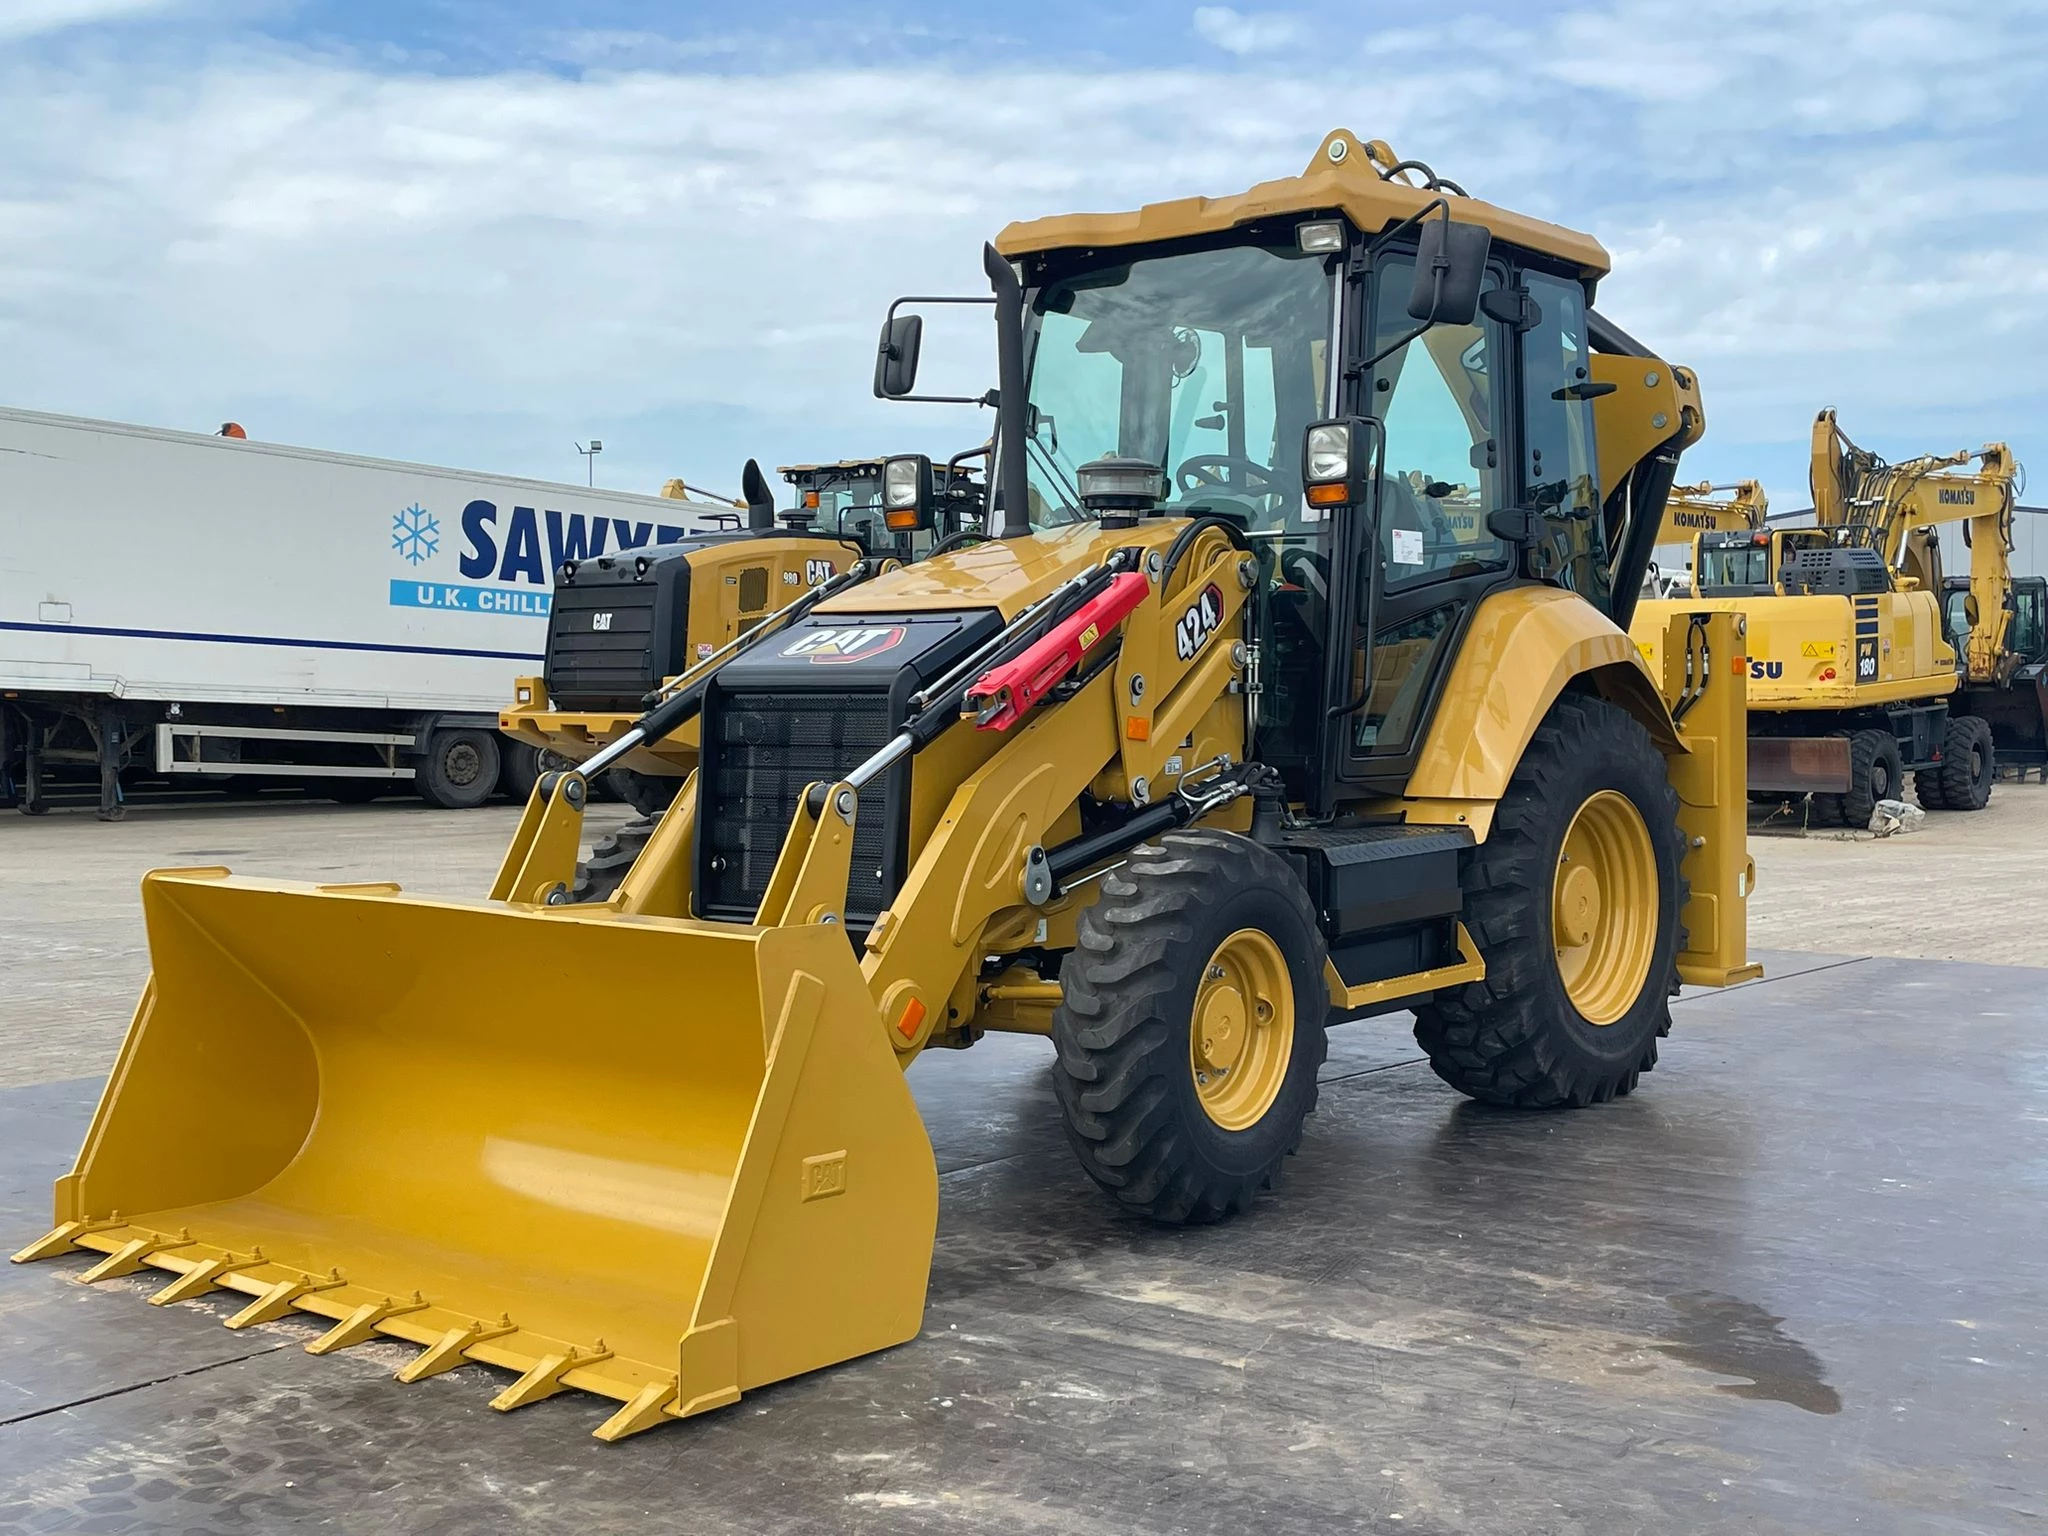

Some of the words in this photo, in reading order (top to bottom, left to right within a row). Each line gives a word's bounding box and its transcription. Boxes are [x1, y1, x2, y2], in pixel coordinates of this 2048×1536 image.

[1938, 485, 1975, 505] KOMATSU
[1674, 511, 1717, 531] KOMATSU
[783, 572, 798, 584] 980
[806, 560, 831, 586] CAT
[417, 586, 467, 608] U.K.
[593, 613, 613, 630] CAT
[1177, 592, 1217, 658] 424
[783, 629, 892, 655] CAT
[1860, 658, 1875, 676] 180
